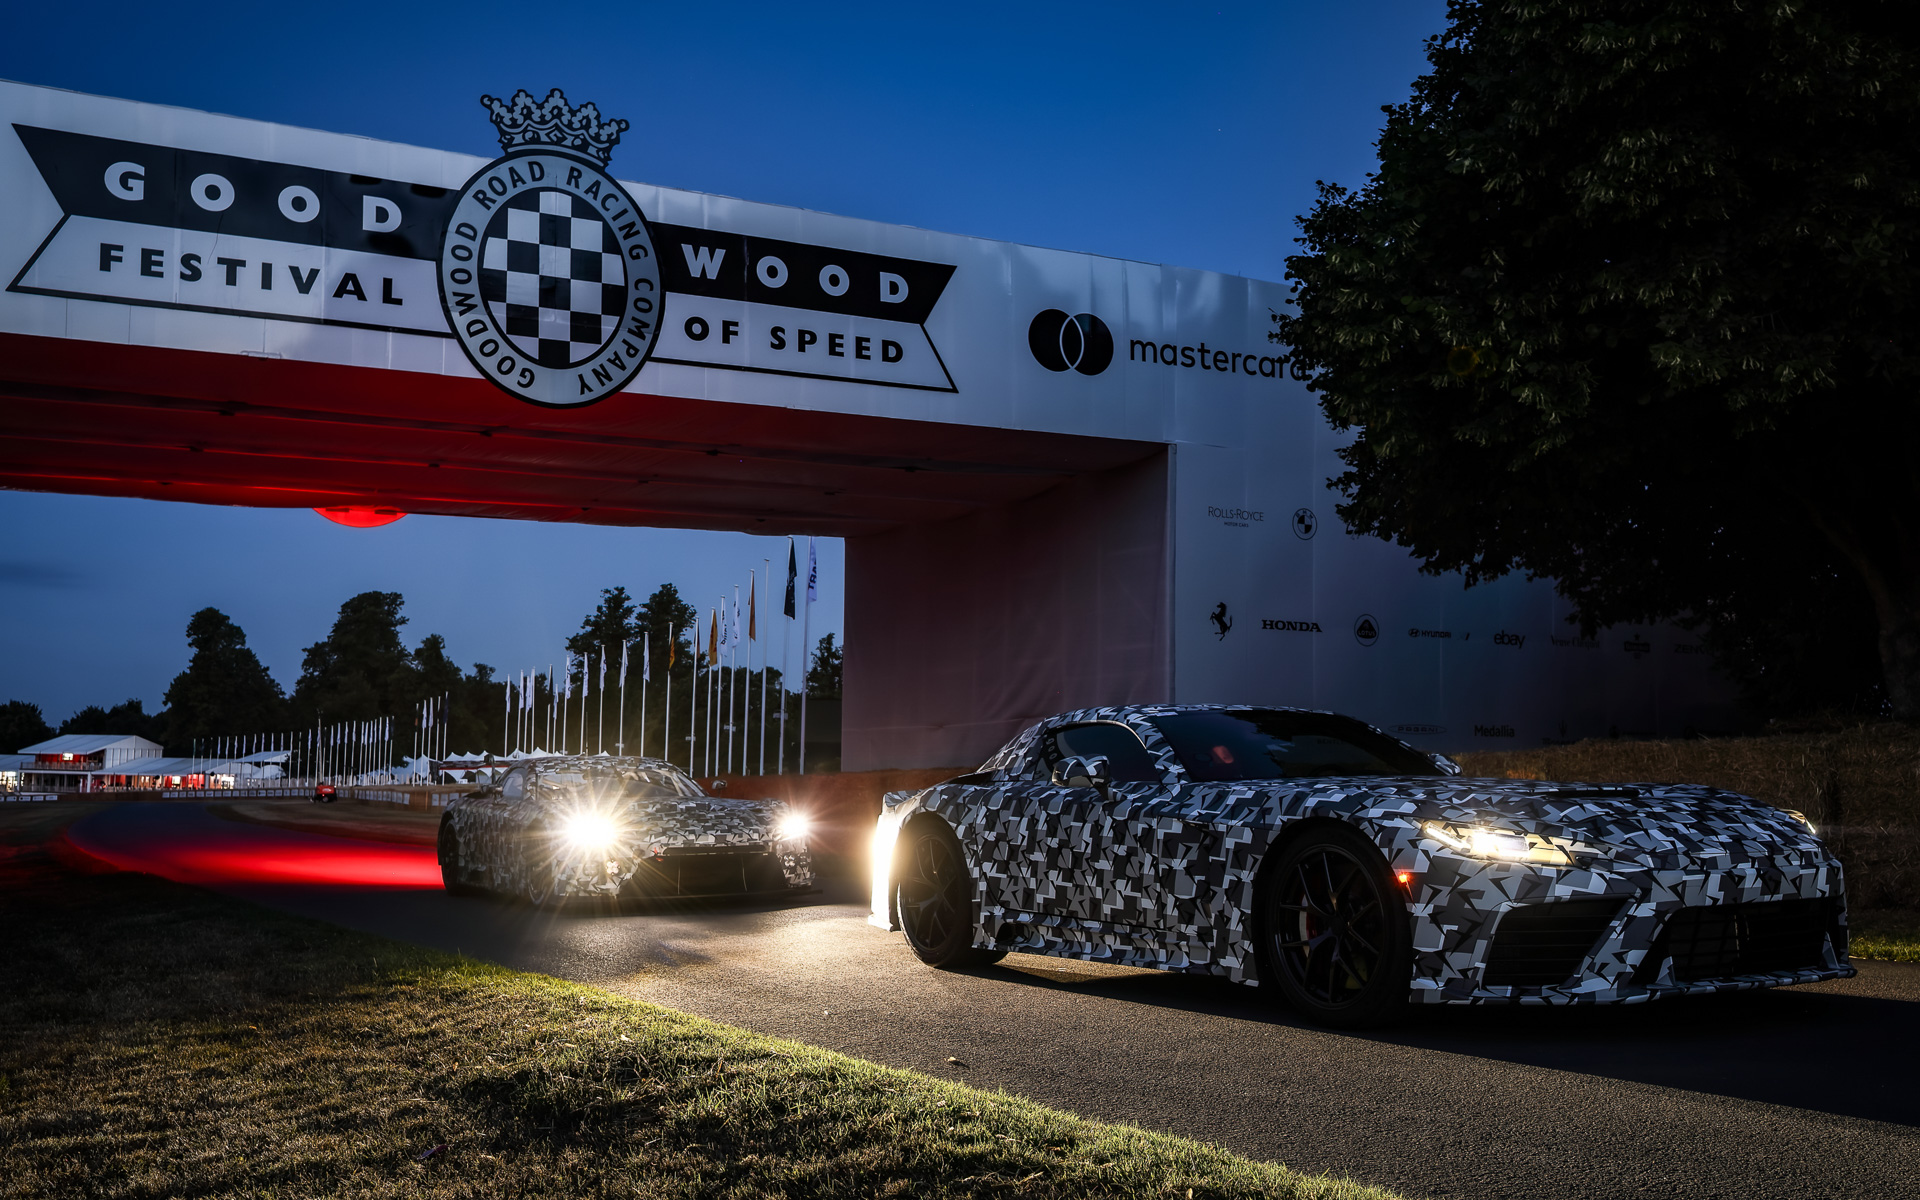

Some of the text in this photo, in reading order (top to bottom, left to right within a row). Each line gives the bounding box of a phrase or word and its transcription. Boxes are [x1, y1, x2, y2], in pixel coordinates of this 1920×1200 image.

[104, 161, 909, 303] GOOD WOOD
[450, 160, 653, 395] GOODWOOD ROAD RACING COMPANY
[99, 242, 904, 363] FESTIVAL OF SPEED
[1208, 506, 1264, 521] ROLLS-ROYCE
[1262, 619, 1322, 632] HONDA
[1421, 630, 1451, 638] HYUNDAI
[1494, 629, 1526, 650] ebay
[1474, 724, 1515, 738] Medallia
